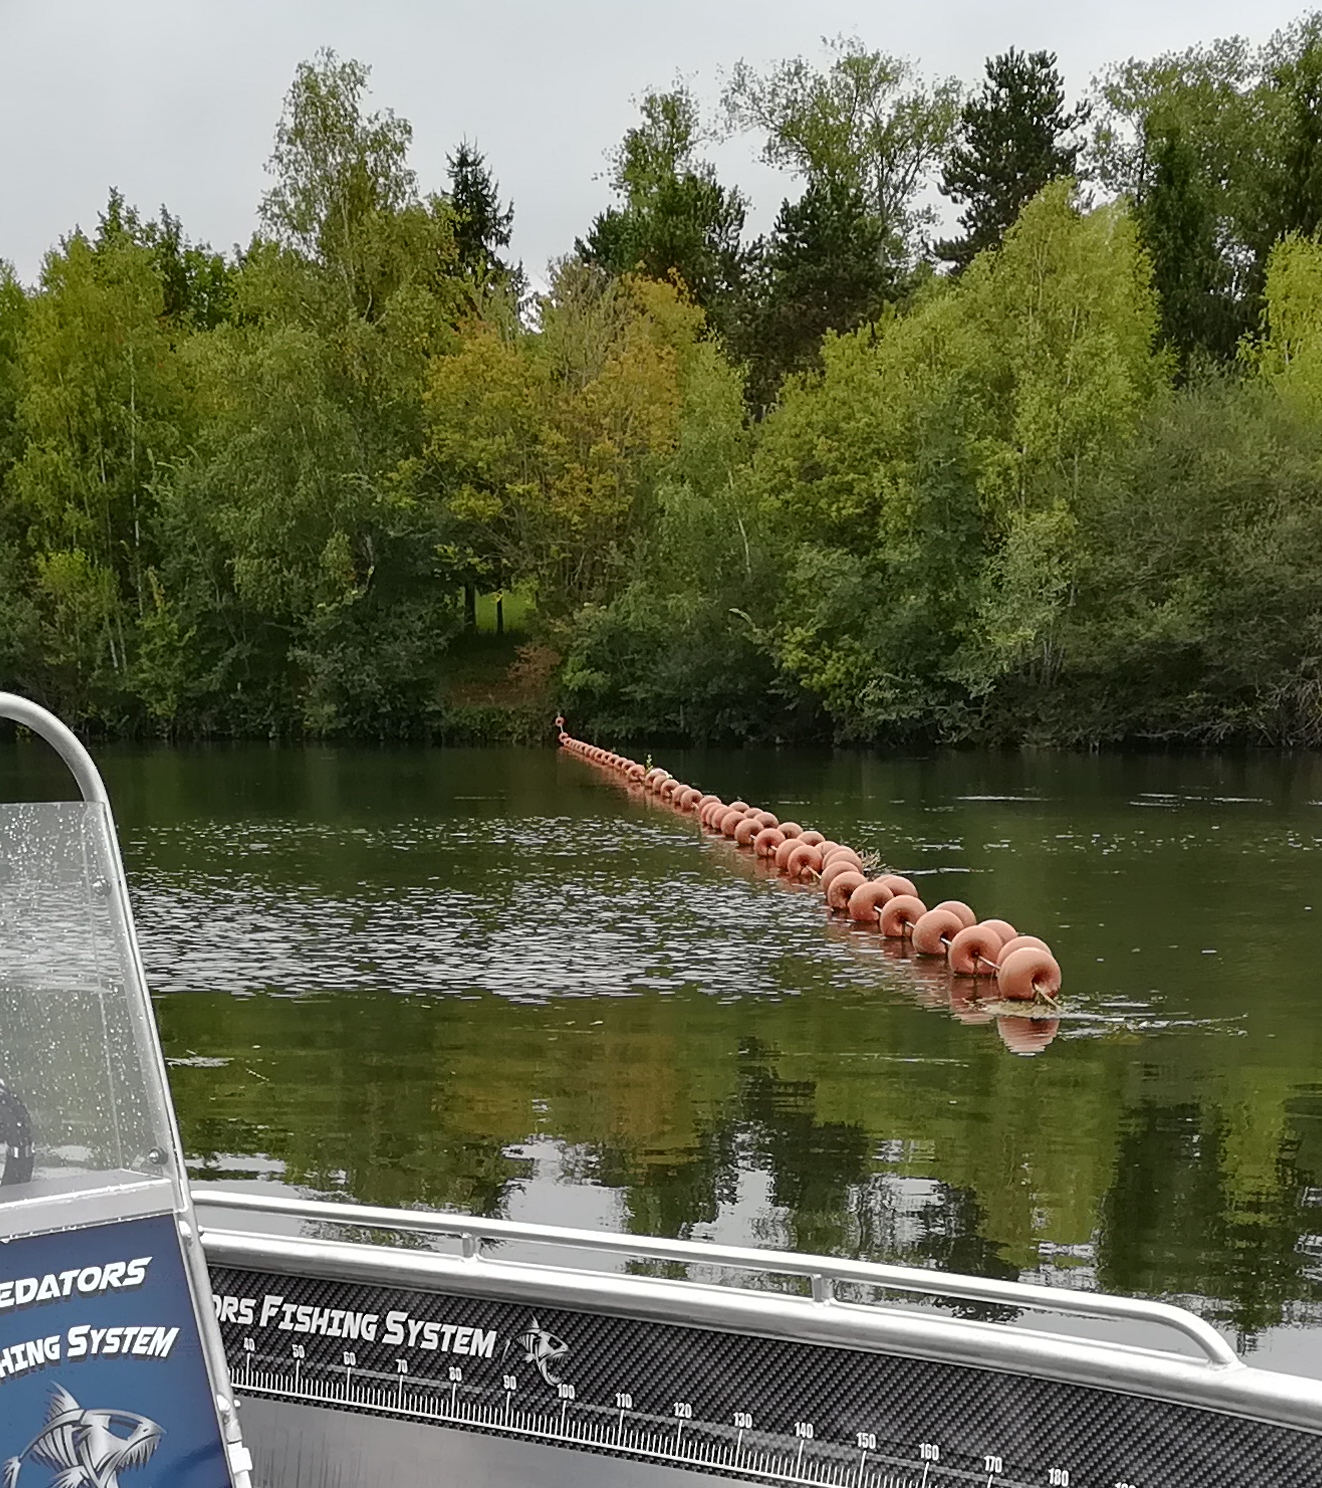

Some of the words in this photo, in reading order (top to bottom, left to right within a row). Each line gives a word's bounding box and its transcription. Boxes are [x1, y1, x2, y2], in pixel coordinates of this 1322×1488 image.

[66, 1324, 180, 1359] SYSTEM
[259, 1294, 380, 1341] FISHING
[381, 1310, 498, 1358] SYSTEM
[243, 1337, 255, 1351] 40
[291, 1344, 305, 1358] 50
[343, 1351, 356, 1366] 60
[395, 1359, 408, 1373] 70
[449, 1367, 462, 1381] 80
[503, 1374, 517, 1390] 90
[558, 1383, 575, 1399] 100
[615, 1392, 633, 1408] 110
[673, 1402, 692, 1418] 120
[733, 1412, 753, 1429] 130
[794, 1422, 814, 1439] 140
[856, 1432, 876, 1449] 150
[919, 1443, 939, 1461] 160
[983, 1455, 1003, 1473] 170
[1048, 1468, 1069, 1487] 180
